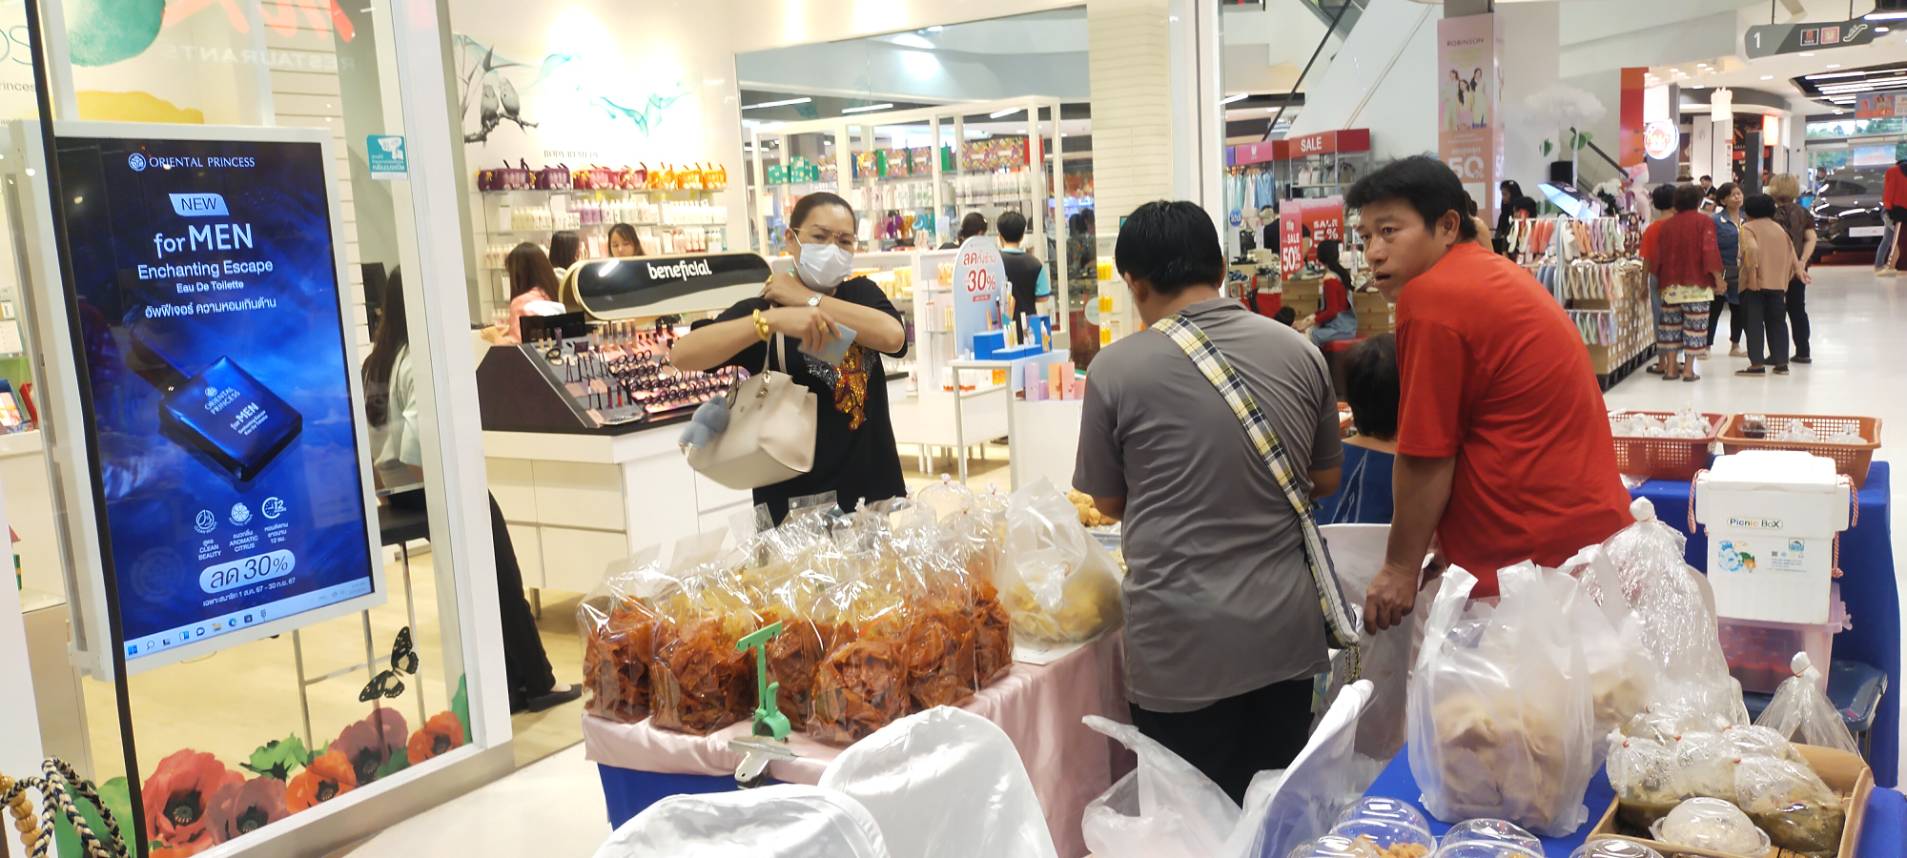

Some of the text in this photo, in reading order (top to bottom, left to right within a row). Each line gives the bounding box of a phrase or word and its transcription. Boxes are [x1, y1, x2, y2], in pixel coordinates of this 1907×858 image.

[1754, 32, 1761, 48] 1
[1300, 137, 1322, 153] SALE
[149, 157, 256, 169] ORIENTAL PRINCESS
[181, 198, 217, 211] NEW
[153, 223, 254, 259] for MEN
[137, 260, 274, 280] Enchanting Escape
[646, 258, 713, 281] beneficial
[176, 280, 244, 293] Eau De Toilette
[967, 268, 996, 292] 30%
[229, 535, 259, 547] AROMATIC
[234, 543, 255, 552] CITRUS
[198, 551, 222, 561] BEAUTY
[200, 544, 219, 554] CLEAN
[210, 555, 289, 589] ลด 30%
